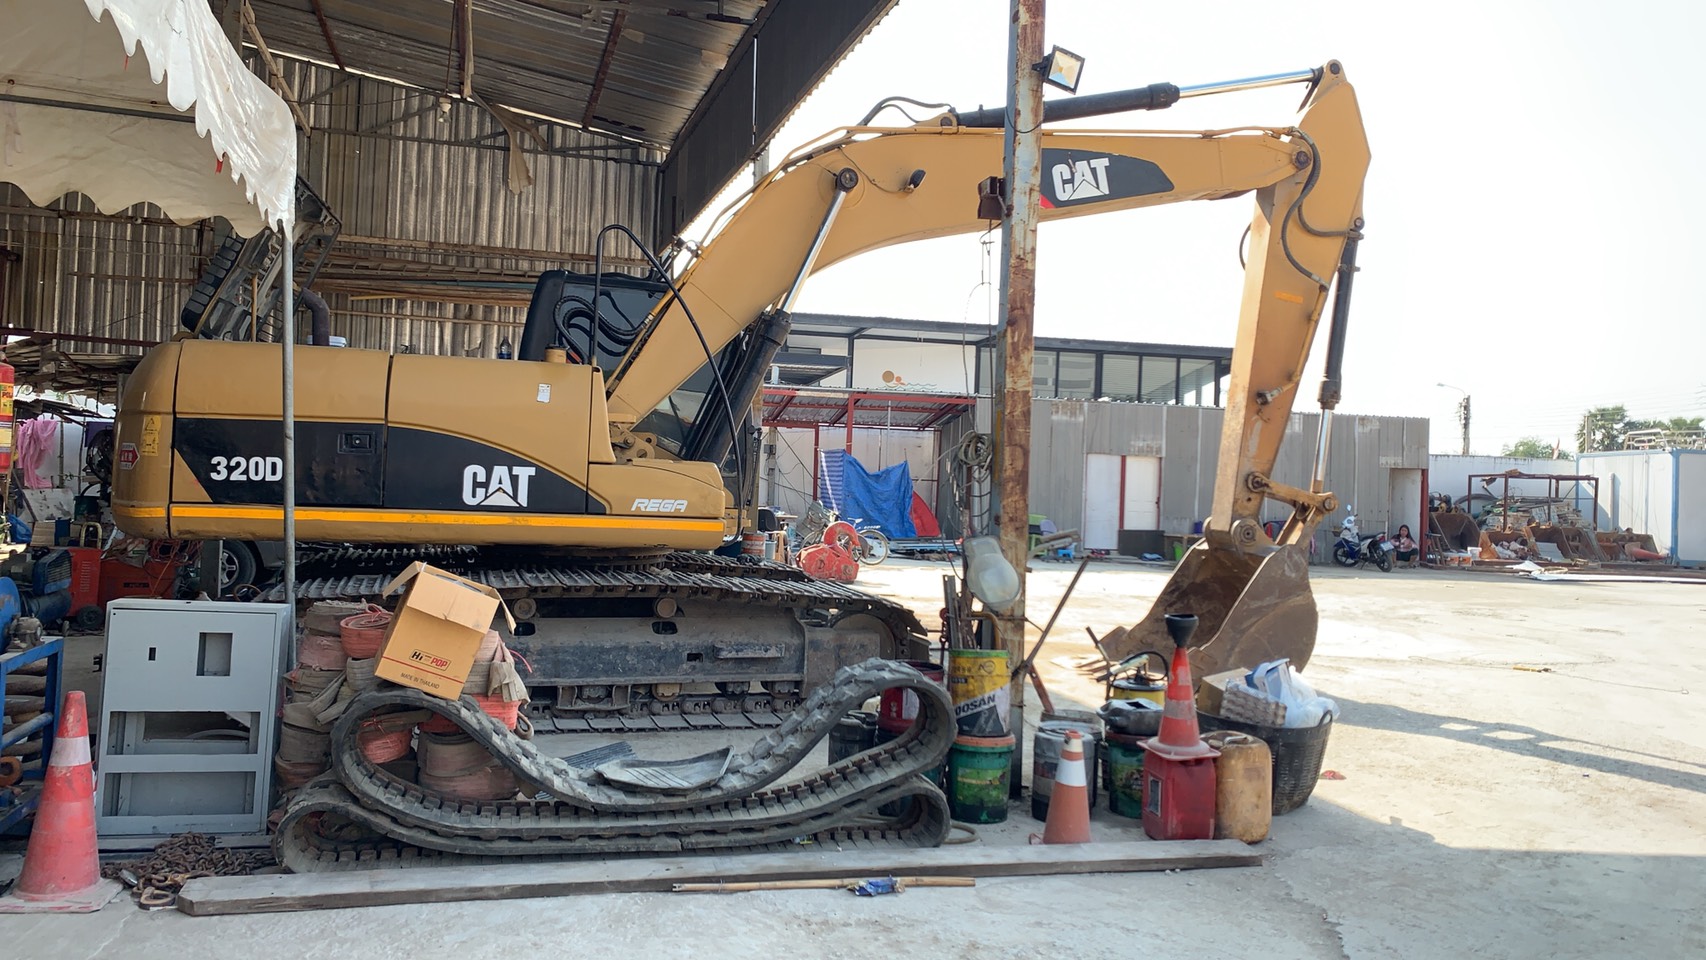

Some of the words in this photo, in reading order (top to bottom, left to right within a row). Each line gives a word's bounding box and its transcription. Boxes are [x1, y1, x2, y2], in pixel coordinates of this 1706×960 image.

[1051, 157, 1110, 201] CAT
[210, 456, 283, 481] 320D
[462, 464, 536, 507] CAT
[630, 498, 689, 513] REGA
[400, 672, 413, 681] MADE
[420, 678, 440, 689] THAILAND
[955, 694, 996, 715] OOSAN
